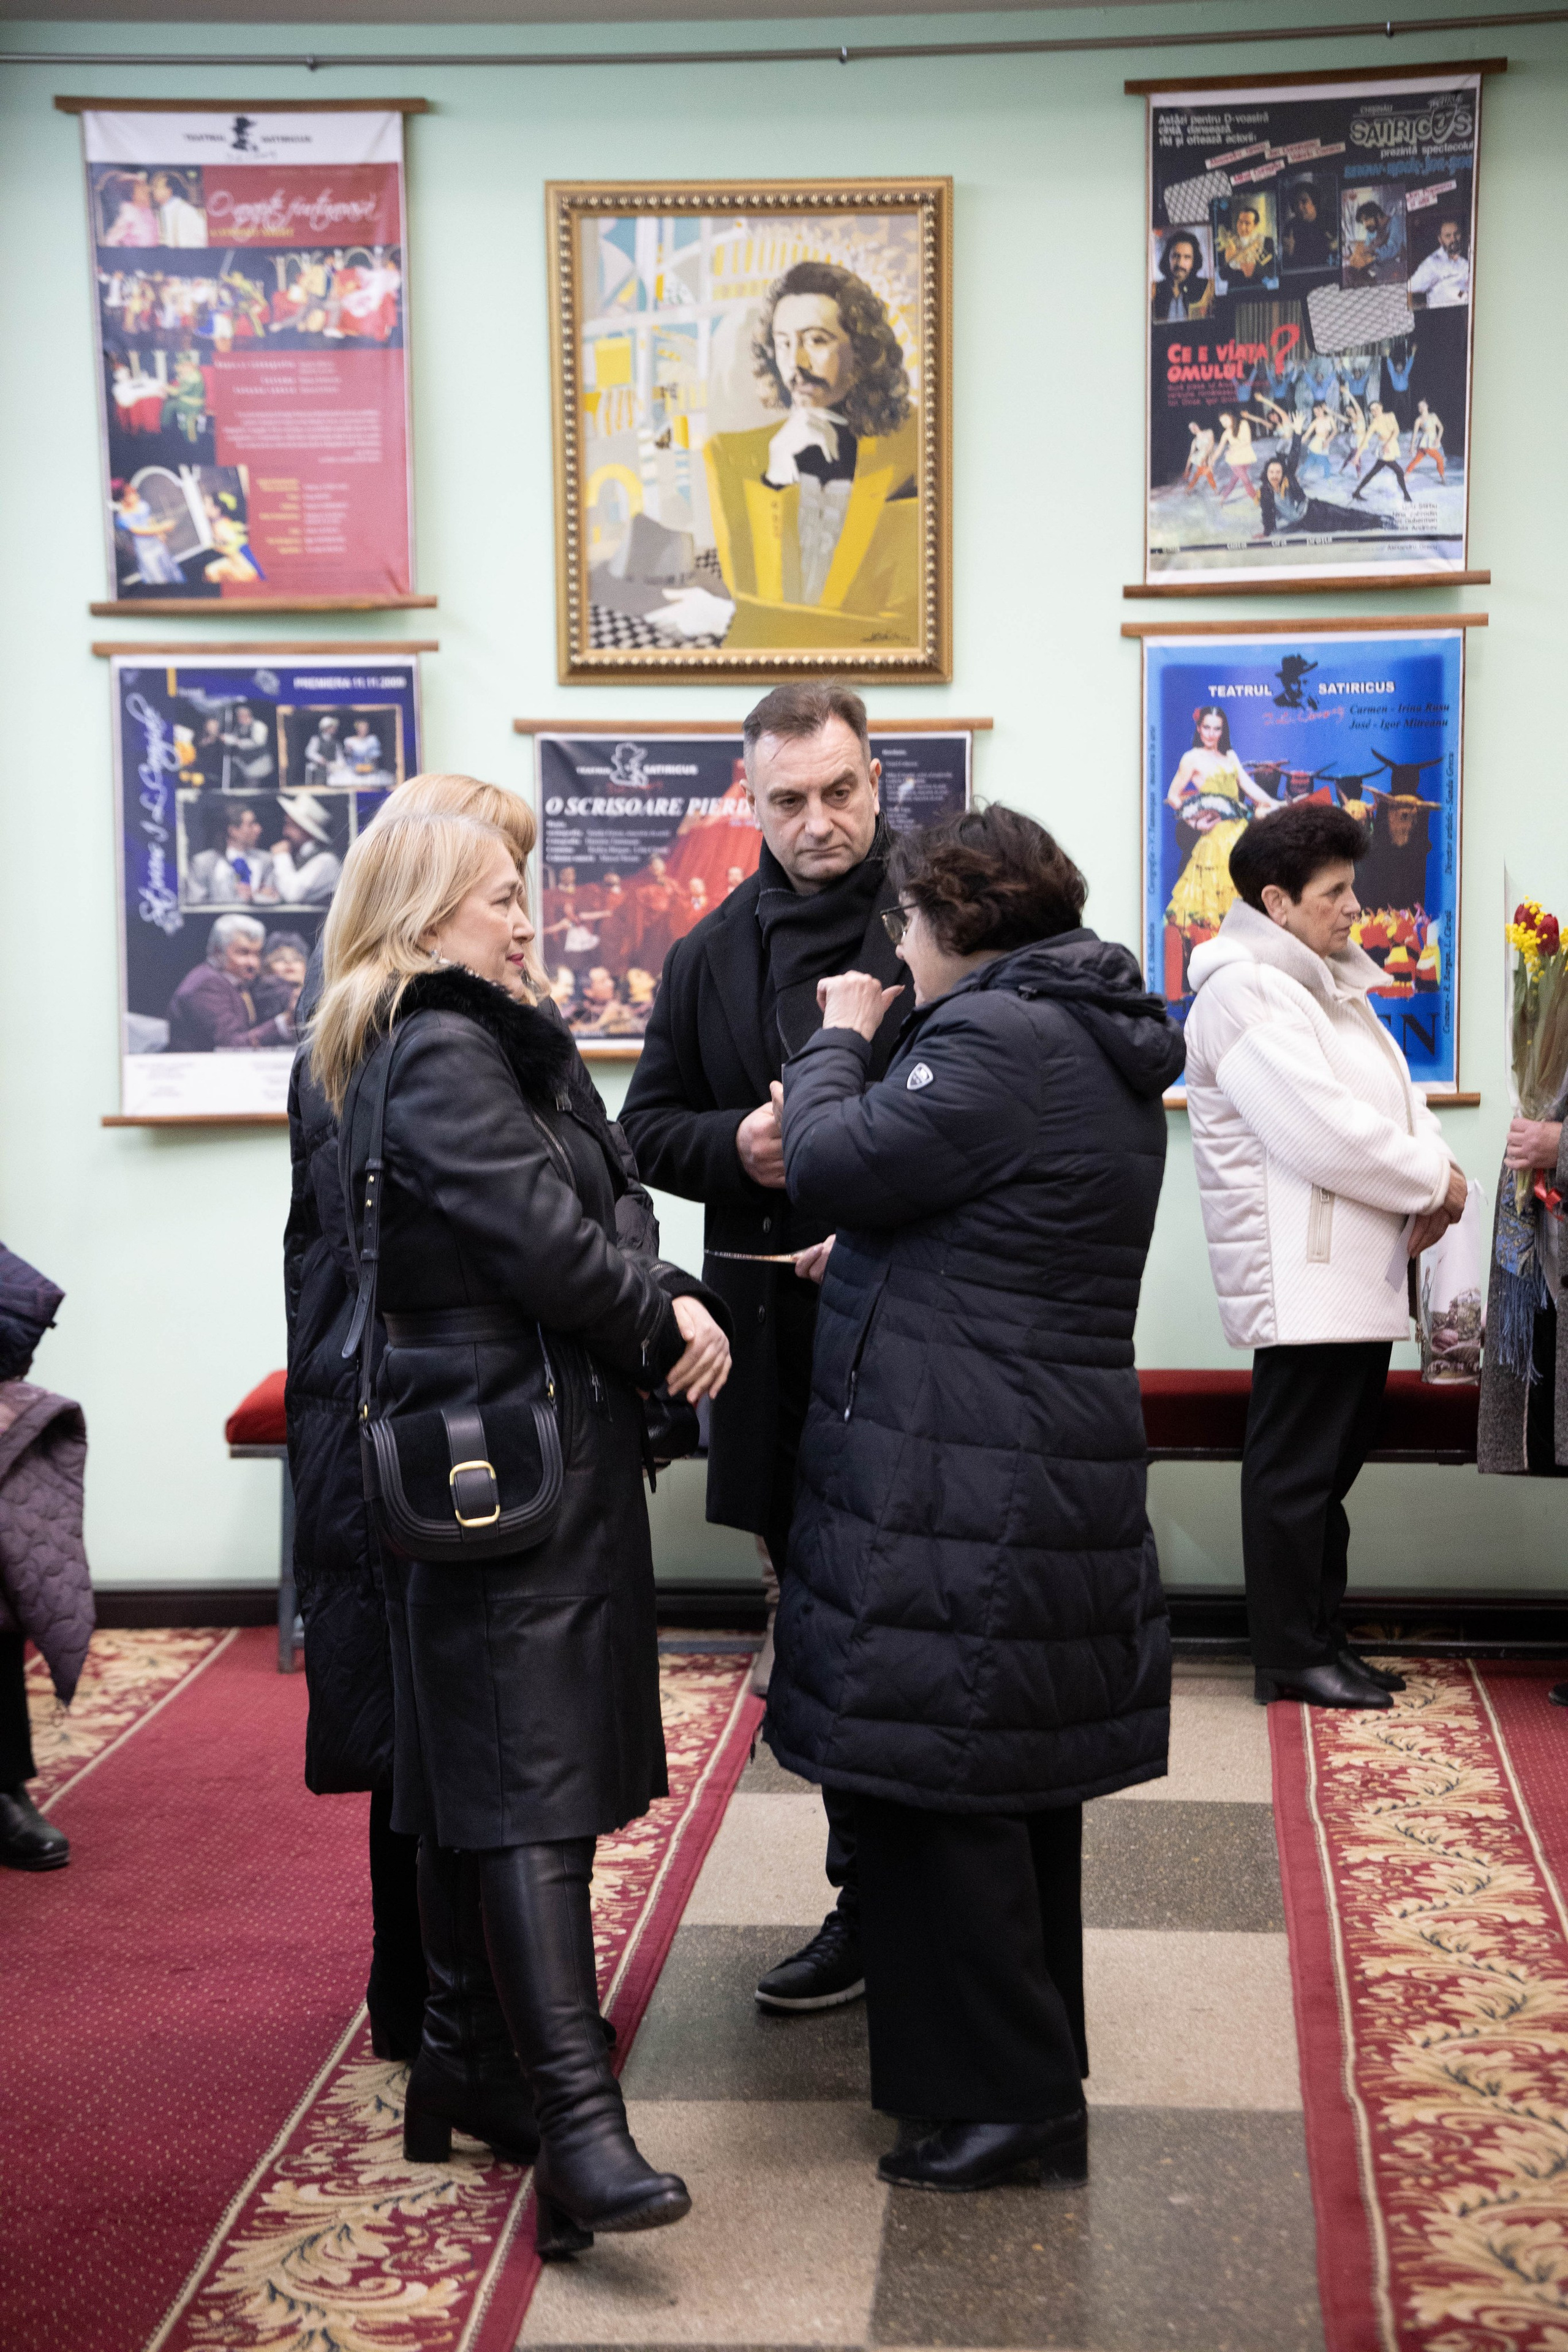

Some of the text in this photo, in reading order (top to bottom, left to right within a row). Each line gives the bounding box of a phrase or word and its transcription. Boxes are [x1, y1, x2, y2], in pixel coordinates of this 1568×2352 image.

[1208, 680, 1395, 698] TEATRUL SATIRICUS
[1349, 704, 1388, 715] Carmen
[545, 796, 752, 817] O SCRISOARE PIERD
